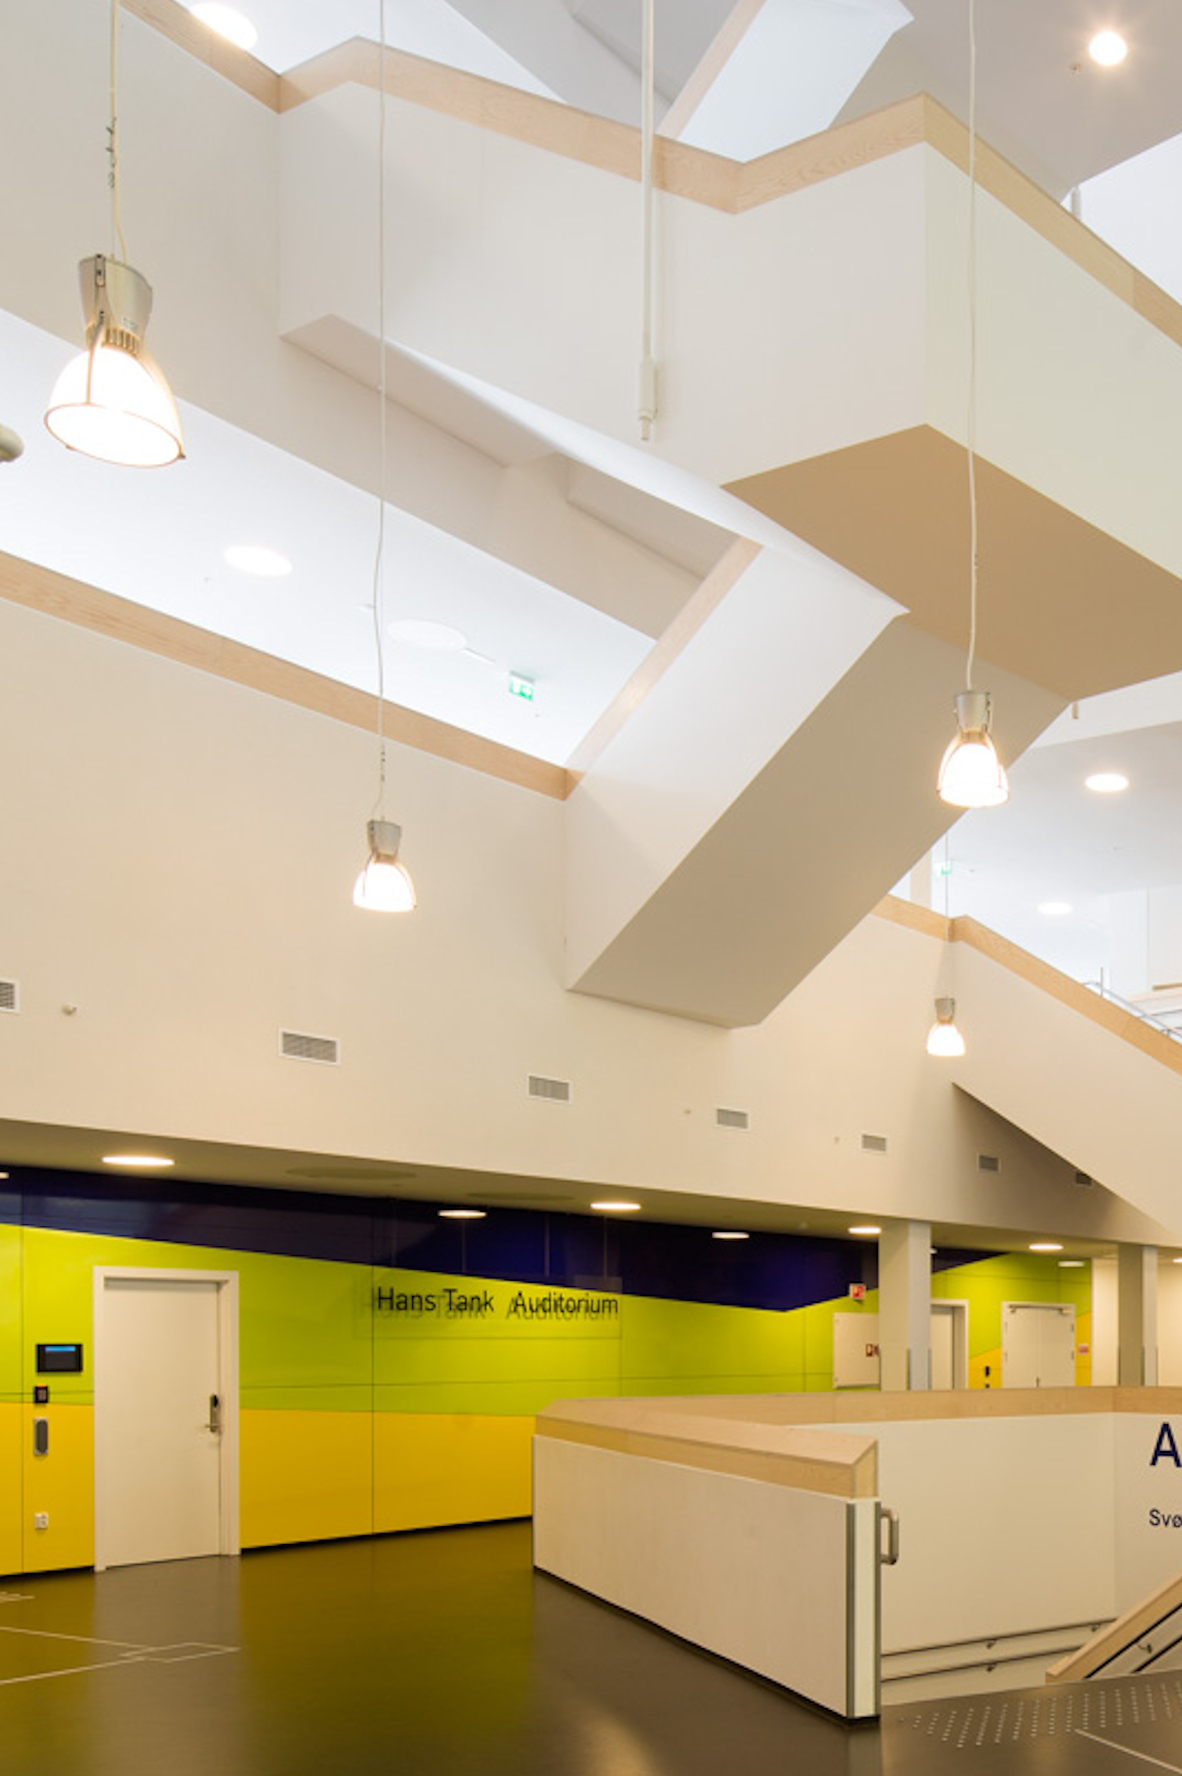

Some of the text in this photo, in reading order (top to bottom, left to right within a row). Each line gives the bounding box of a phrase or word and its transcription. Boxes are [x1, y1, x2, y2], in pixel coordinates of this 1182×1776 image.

[377, 1286, 618, 1314] Hans Tank Auditorium
